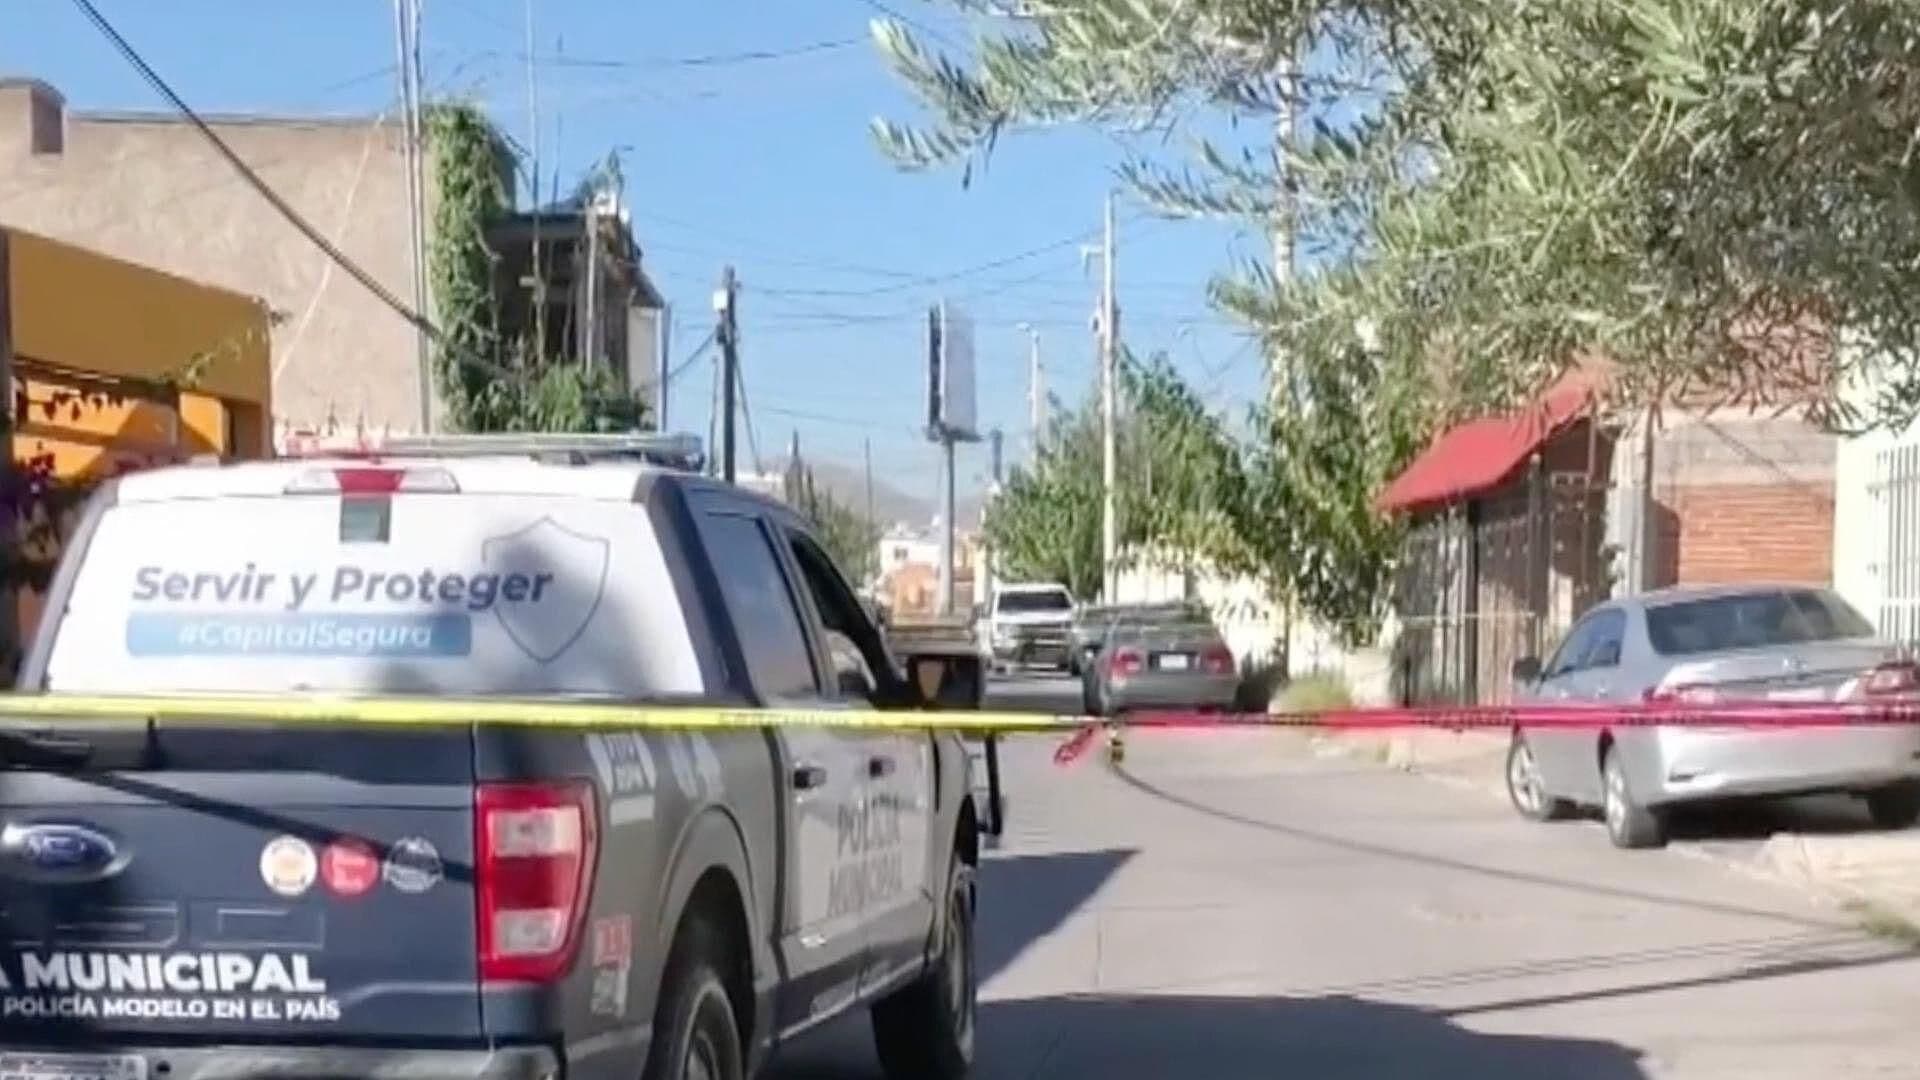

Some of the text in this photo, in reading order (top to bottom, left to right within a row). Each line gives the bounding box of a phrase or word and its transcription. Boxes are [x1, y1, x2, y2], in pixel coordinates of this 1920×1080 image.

[132, 562, 553, 610] Servir y Proteger
[177, 618, 434, 652] #CapitalSegura
[20, 952, 327, 992] MUNICIPAL
[3, 992, 341, 1021] POLICÍA MODELO EN EL PAÍS
